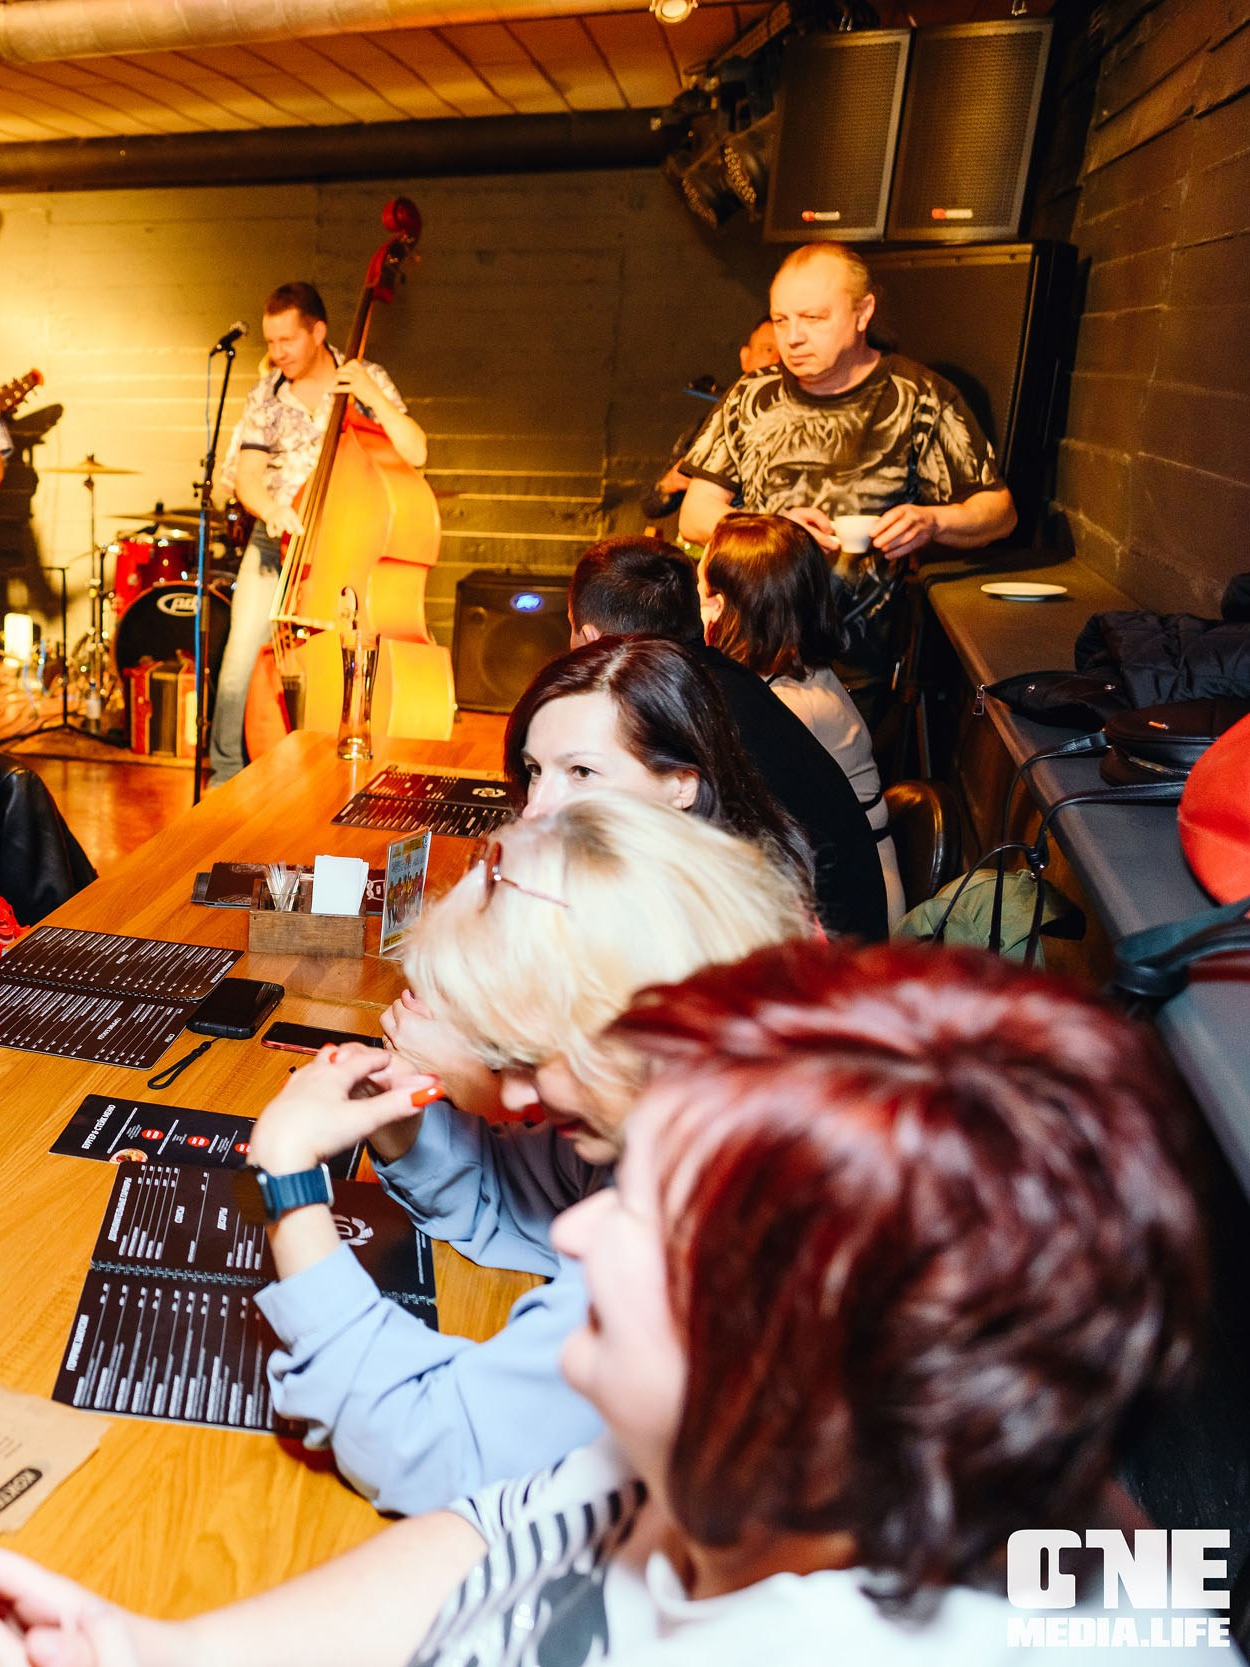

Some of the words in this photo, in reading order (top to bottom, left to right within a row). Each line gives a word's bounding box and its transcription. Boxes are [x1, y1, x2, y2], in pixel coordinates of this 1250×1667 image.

[81, 1132, 98, 1150] БУРГЕР
[93, 1115, 108, 1131] СТЕЙК
[103, 1104, 117, 1119] МЕНЮ
